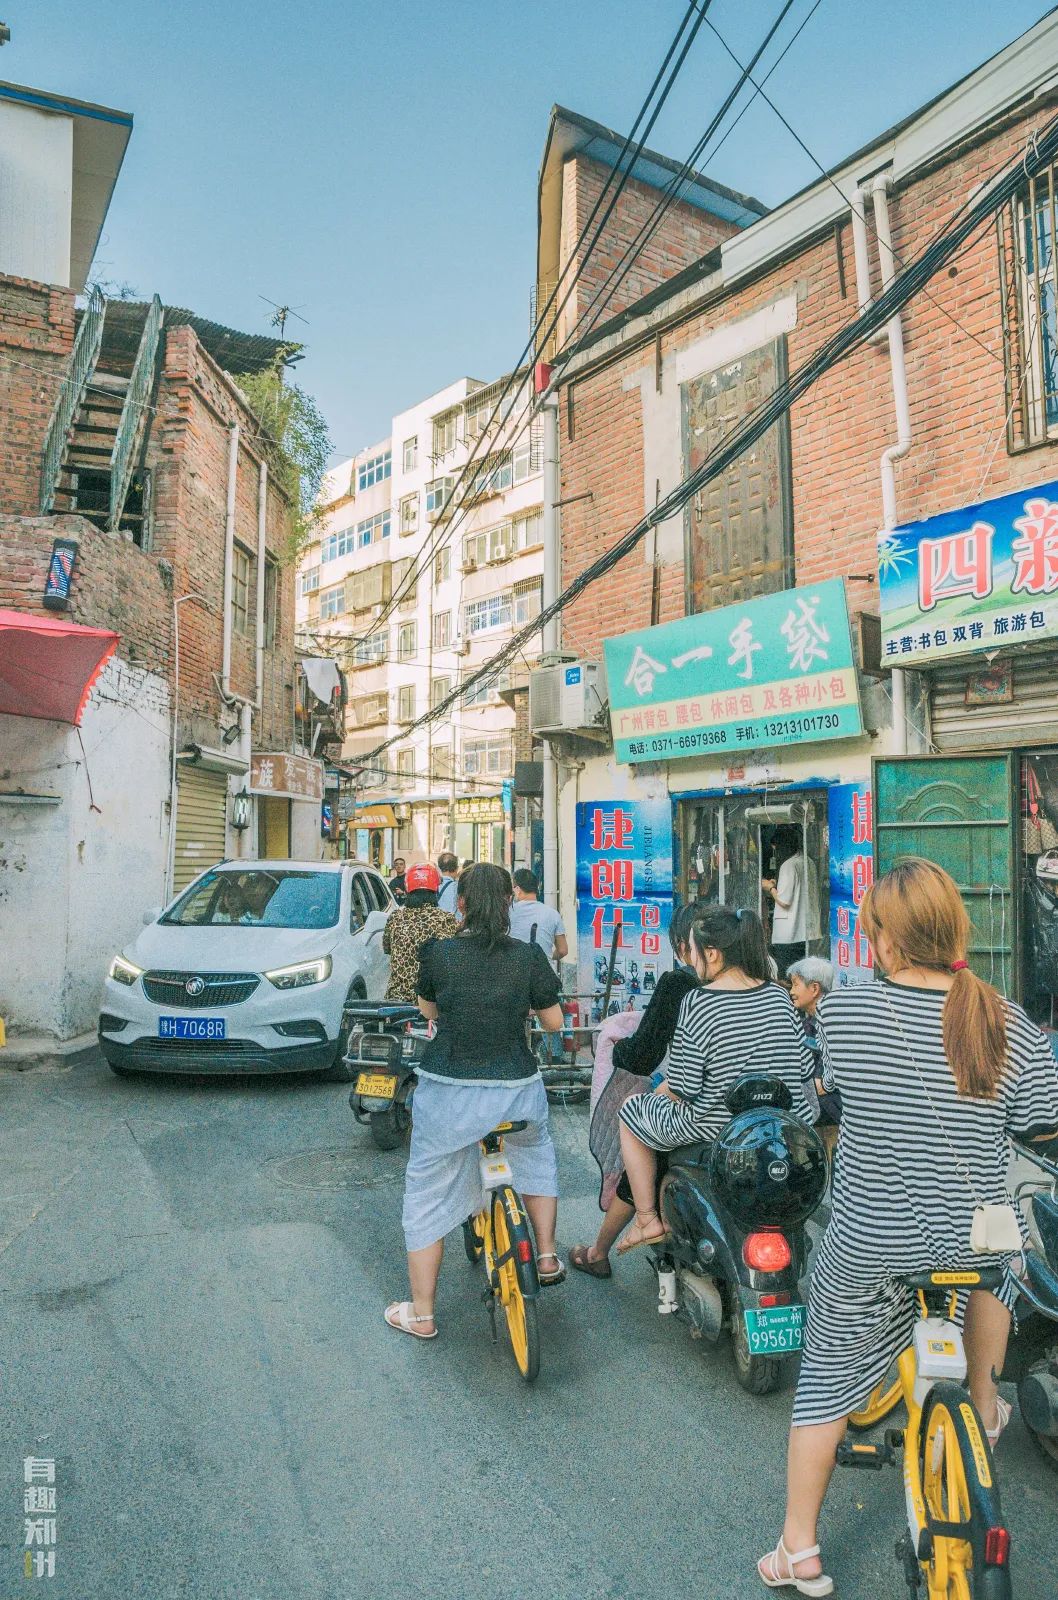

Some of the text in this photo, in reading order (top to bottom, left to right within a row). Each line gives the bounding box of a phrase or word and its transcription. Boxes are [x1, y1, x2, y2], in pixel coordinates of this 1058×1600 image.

[624, 596, 830, 696] 合一手袋
[953, 622, 984, 643] 双背
[993, 611, 1046, 635] 旅游包
[619, 676, 847, 733] 广州背包 腰包 休闲包 及各种小包
[591, 808, 634, 949] 捷朗仕
[639, 904, 661, 955] 包包
[837, 906, 850, 968] 包包
[751, 1327, 802, 1350] 995679
